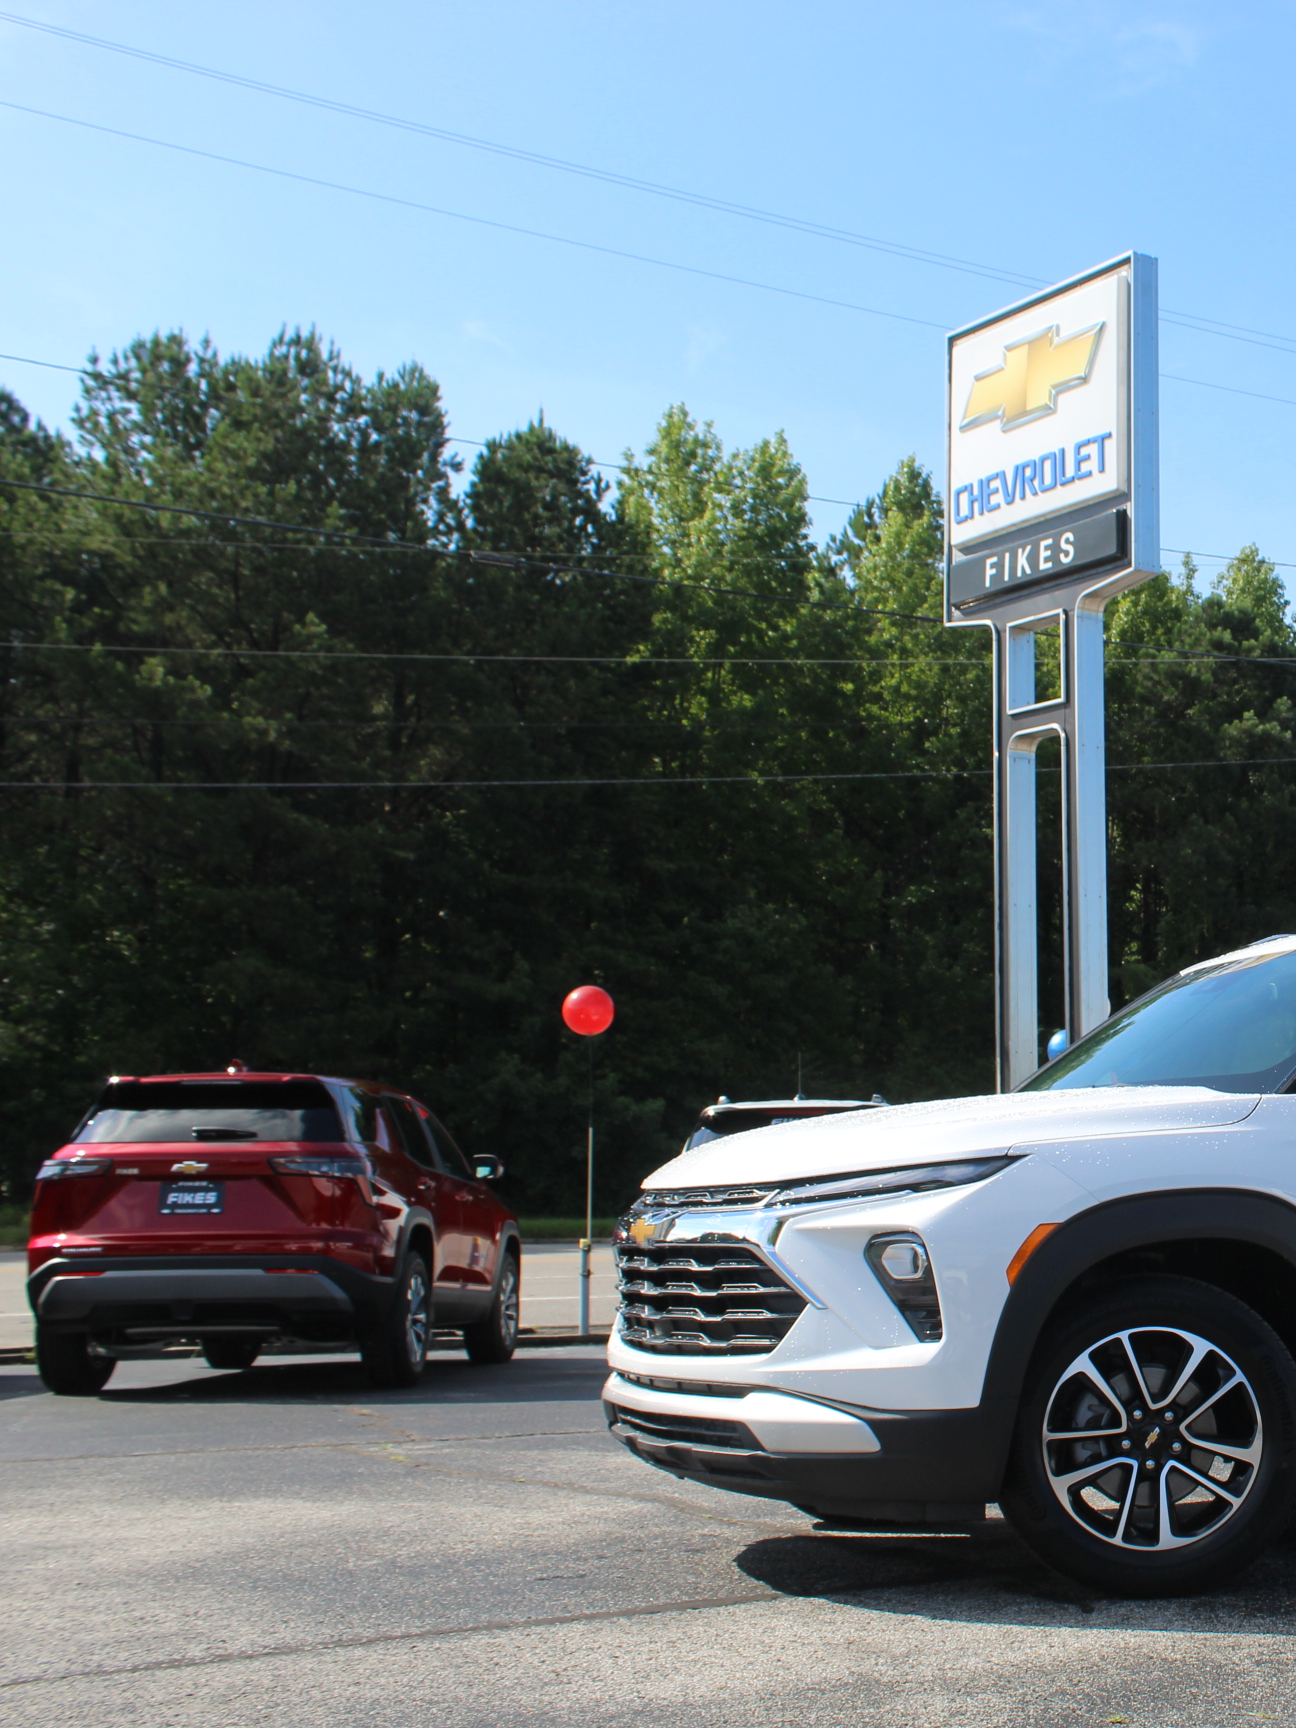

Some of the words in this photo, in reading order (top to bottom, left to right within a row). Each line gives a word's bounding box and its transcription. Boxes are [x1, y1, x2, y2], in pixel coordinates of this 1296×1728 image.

[955, 432, 1111, 524] CHEVROLET
[985, 531, 1075, 588] FIKES
[167, 1192, 217, 1204] FIKES
[1260, 1354, 1296, 1442] Continental
